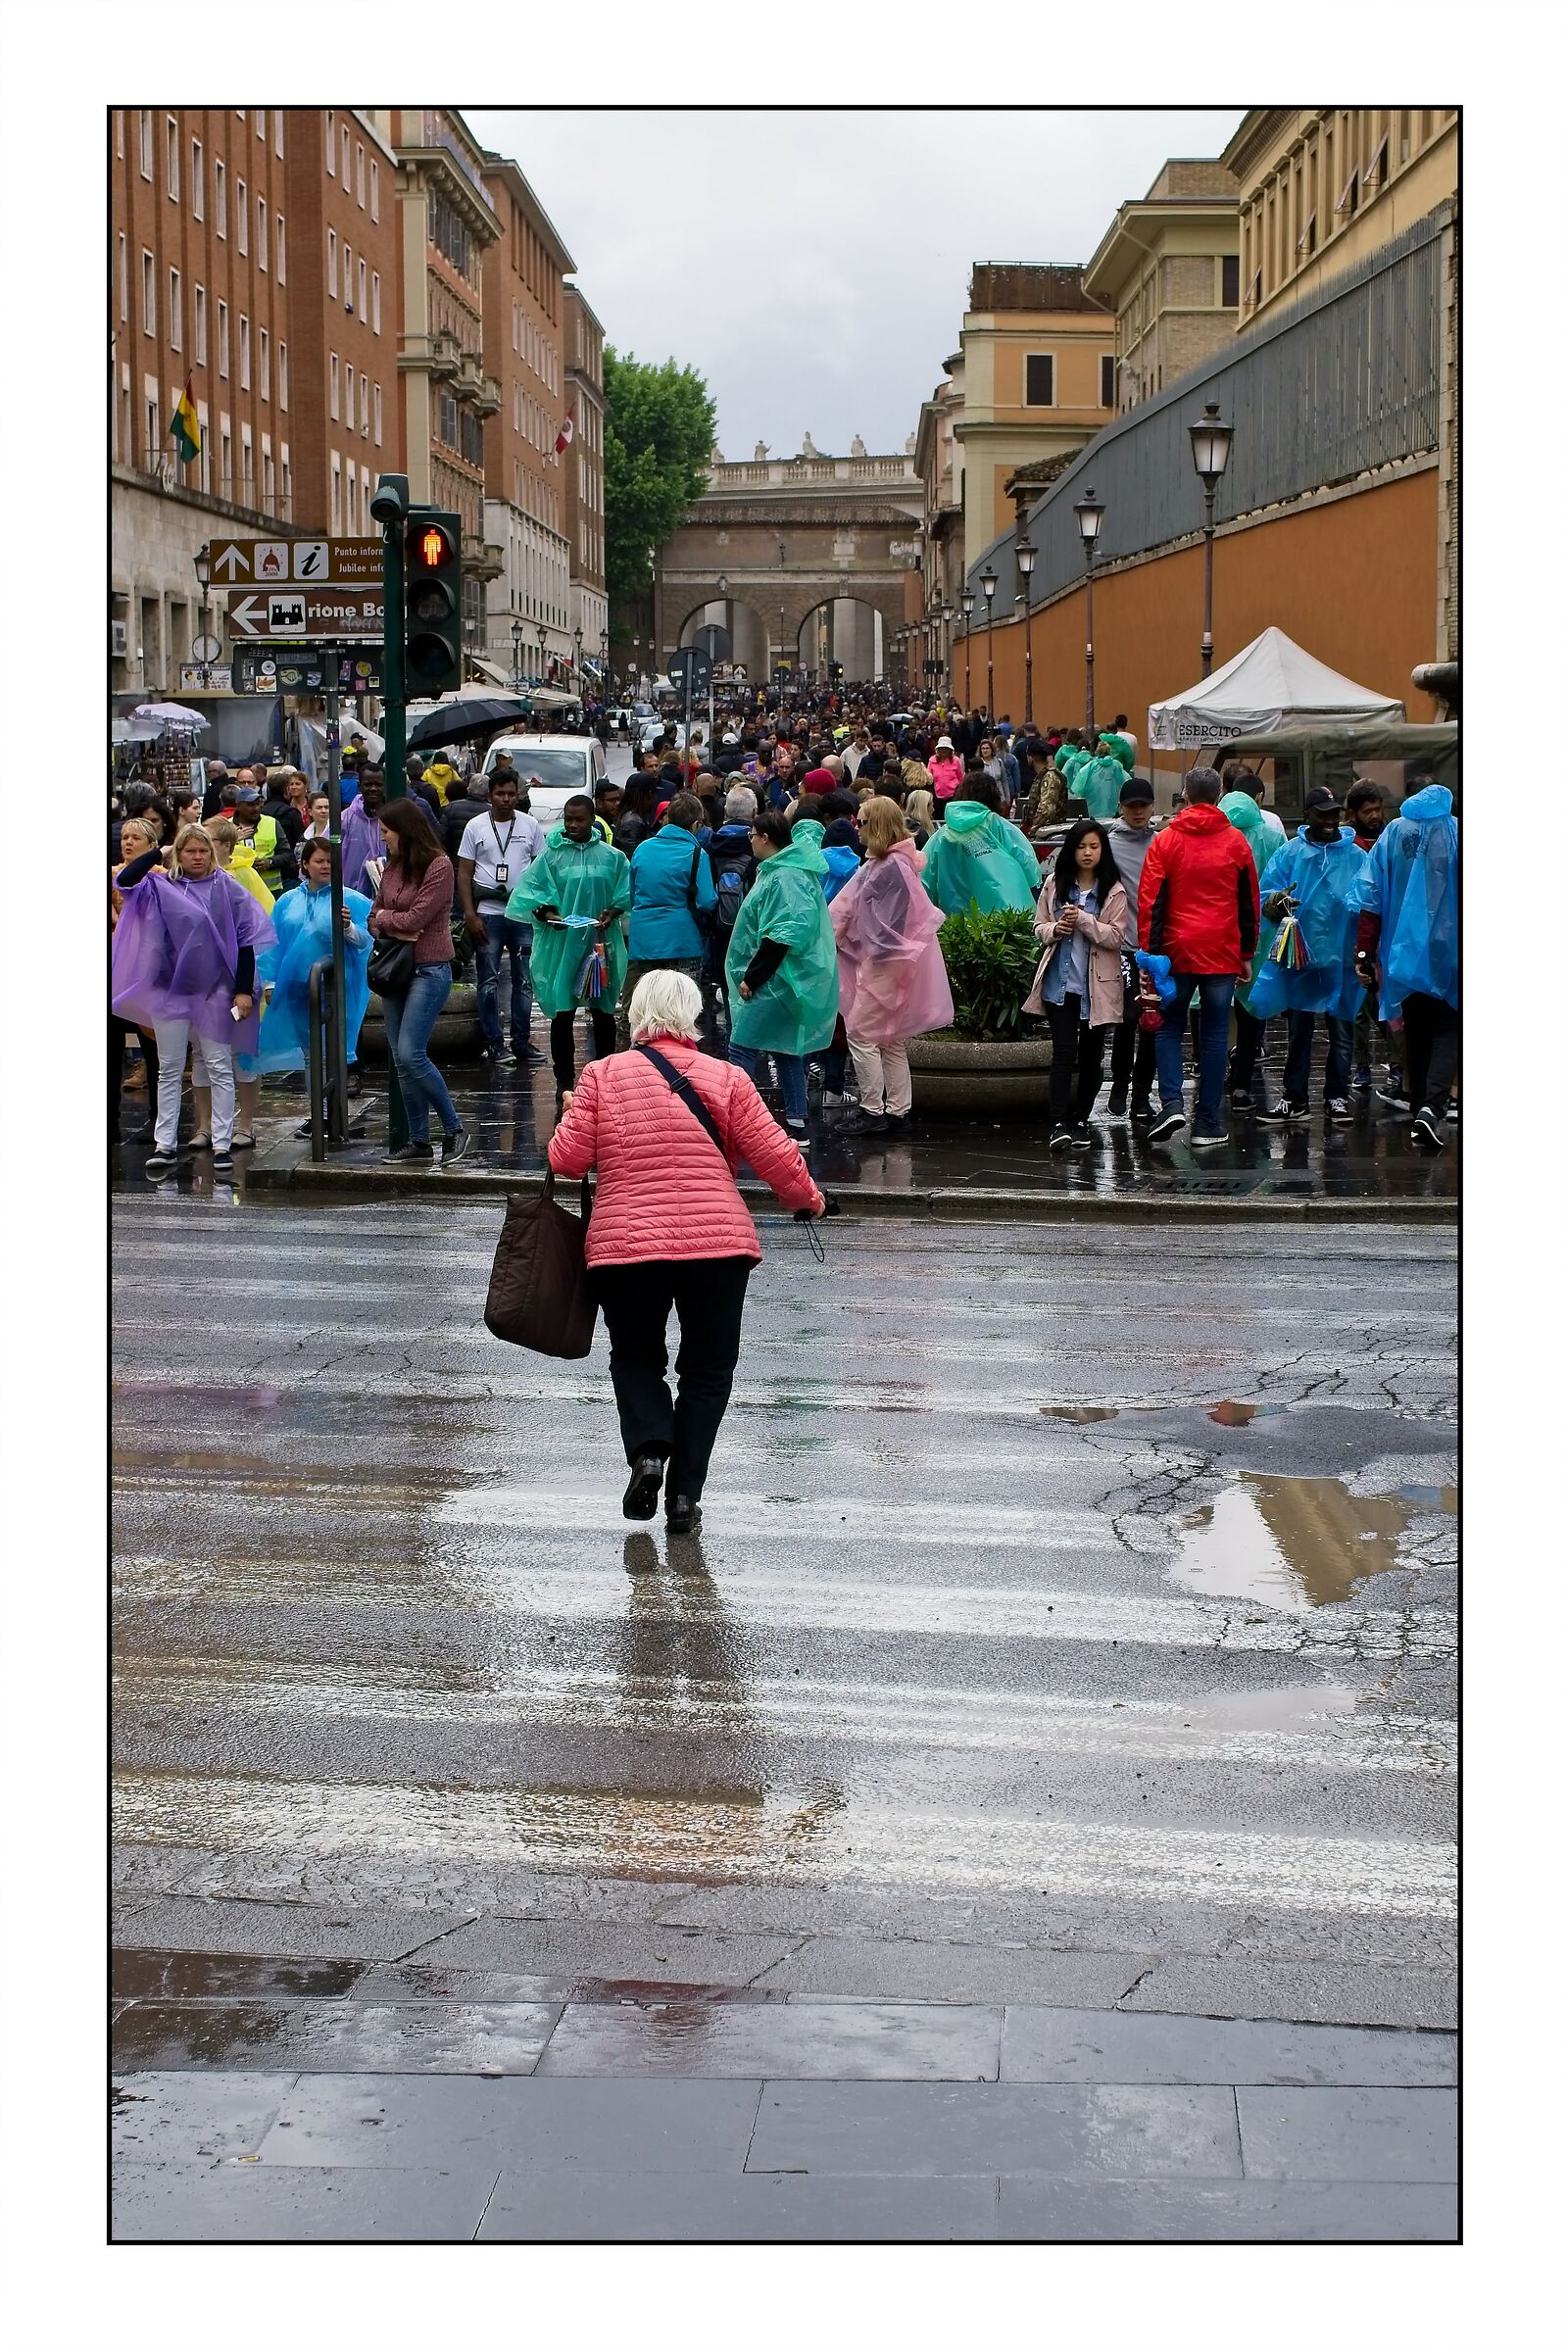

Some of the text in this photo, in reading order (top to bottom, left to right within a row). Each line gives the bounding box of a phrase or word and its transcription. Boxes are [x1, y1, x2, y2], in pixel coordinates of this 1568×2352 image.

[334, 546, 384, 557] Punto inform
[338, 563, 367, 573] Jubilee
[308, 603, 357, 618] rione
[1179, 724, 1242, 737] ESERCITO
